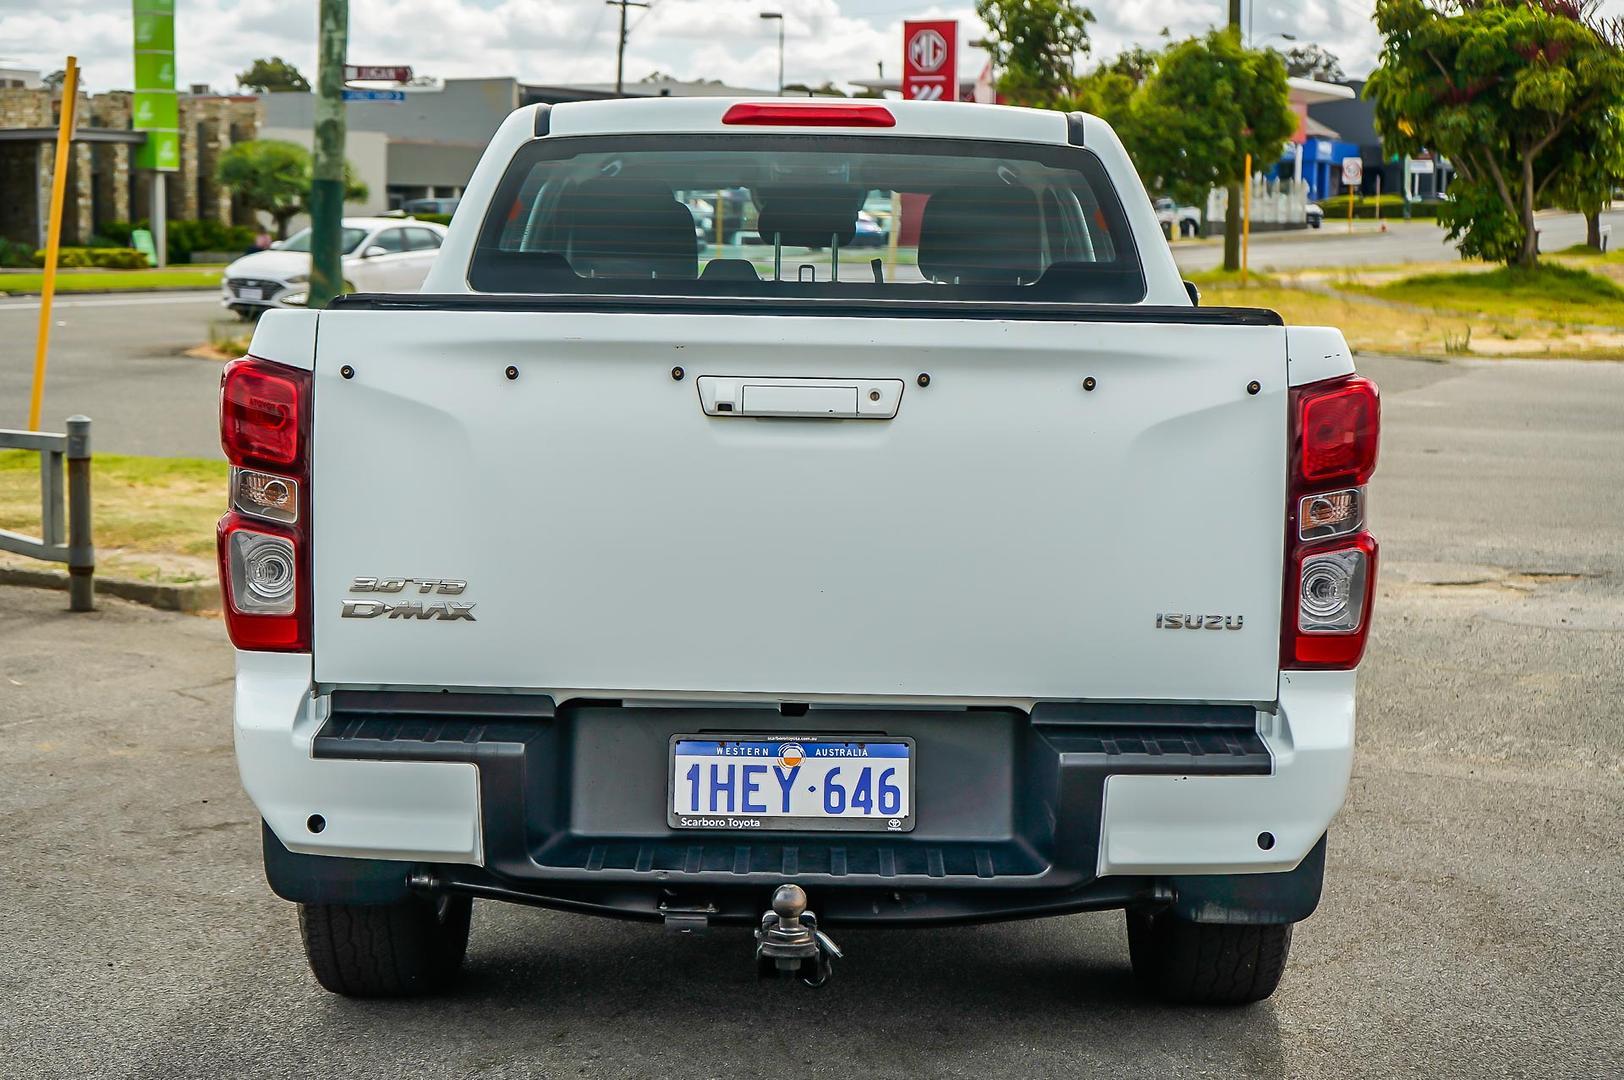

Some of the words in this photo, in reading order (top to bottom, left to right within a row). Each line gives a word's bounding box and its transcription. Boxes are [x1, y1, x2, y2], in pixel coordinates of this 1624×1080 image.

[910, 31, 946, 70] MG
[349, 576, 406, 593] 3.0
[341, 599, 477, 622] D-MAX
[1156, 613, 1244, 631] ISUZU
[716, 747, 769, 756] WESTERN
[815, 748, 869, 757] AUSTRALIA
[681, 817, 726, 827] Scarboro
[727, 818, 761, 829] Toyota
